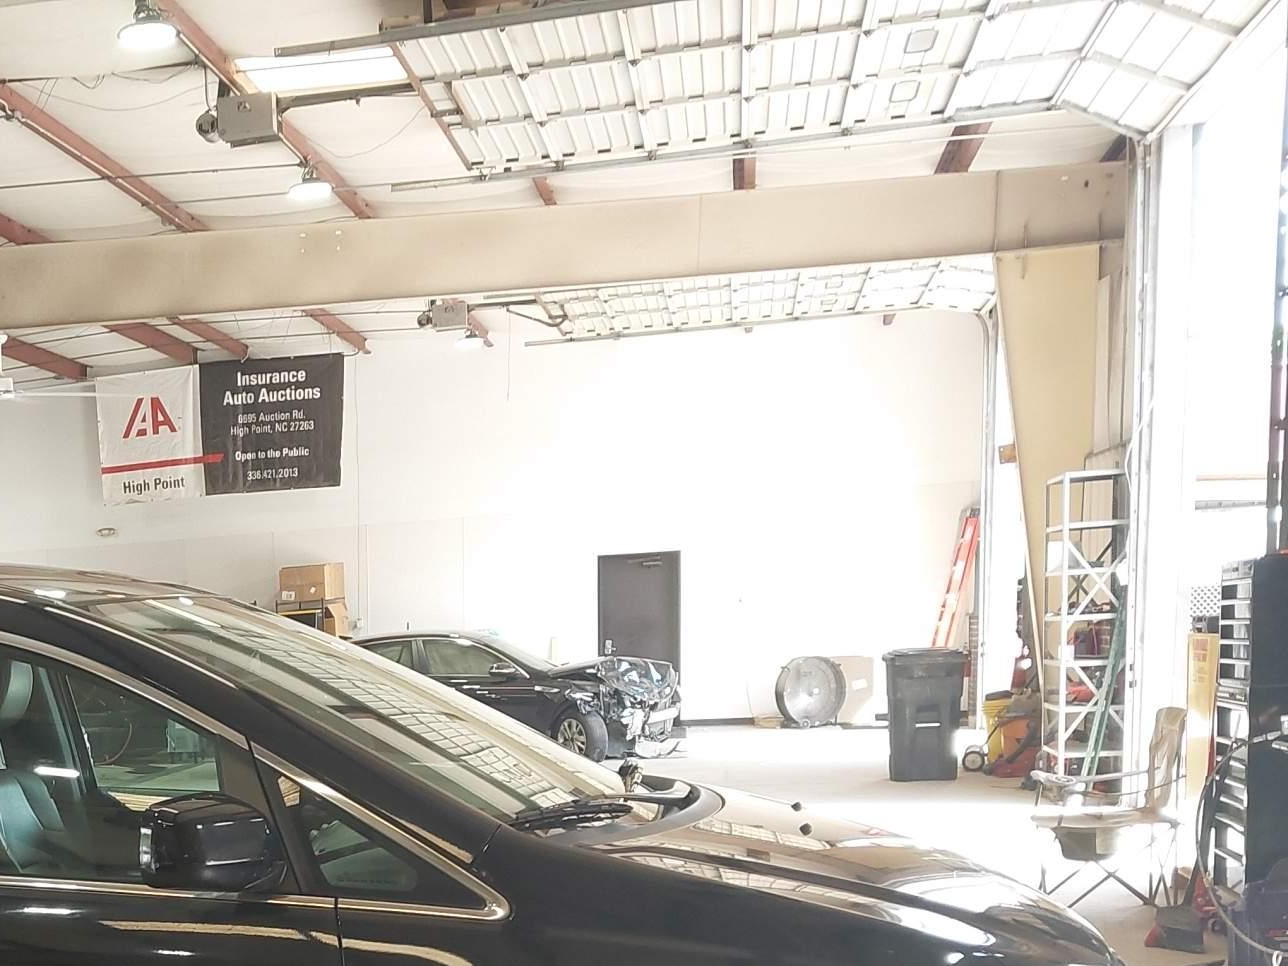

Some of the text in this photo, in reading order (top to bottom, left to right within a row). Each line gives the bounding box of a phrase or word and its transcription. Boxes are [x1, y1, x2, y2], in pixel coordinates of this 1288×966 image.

[237, 370, 306, 386] Insurance
[223, 386, 321, 406] Auto Auctions
[123, 396, 178, 438] IAA
[259, 411, 291, 422] Auction
[293, 409, 306, 420] Rd.
[230, 420, 314, 437] High Point, NC 27263
[235, 447, 310, 462] Open to the Public
[123, 476, 185, 495] High Point
